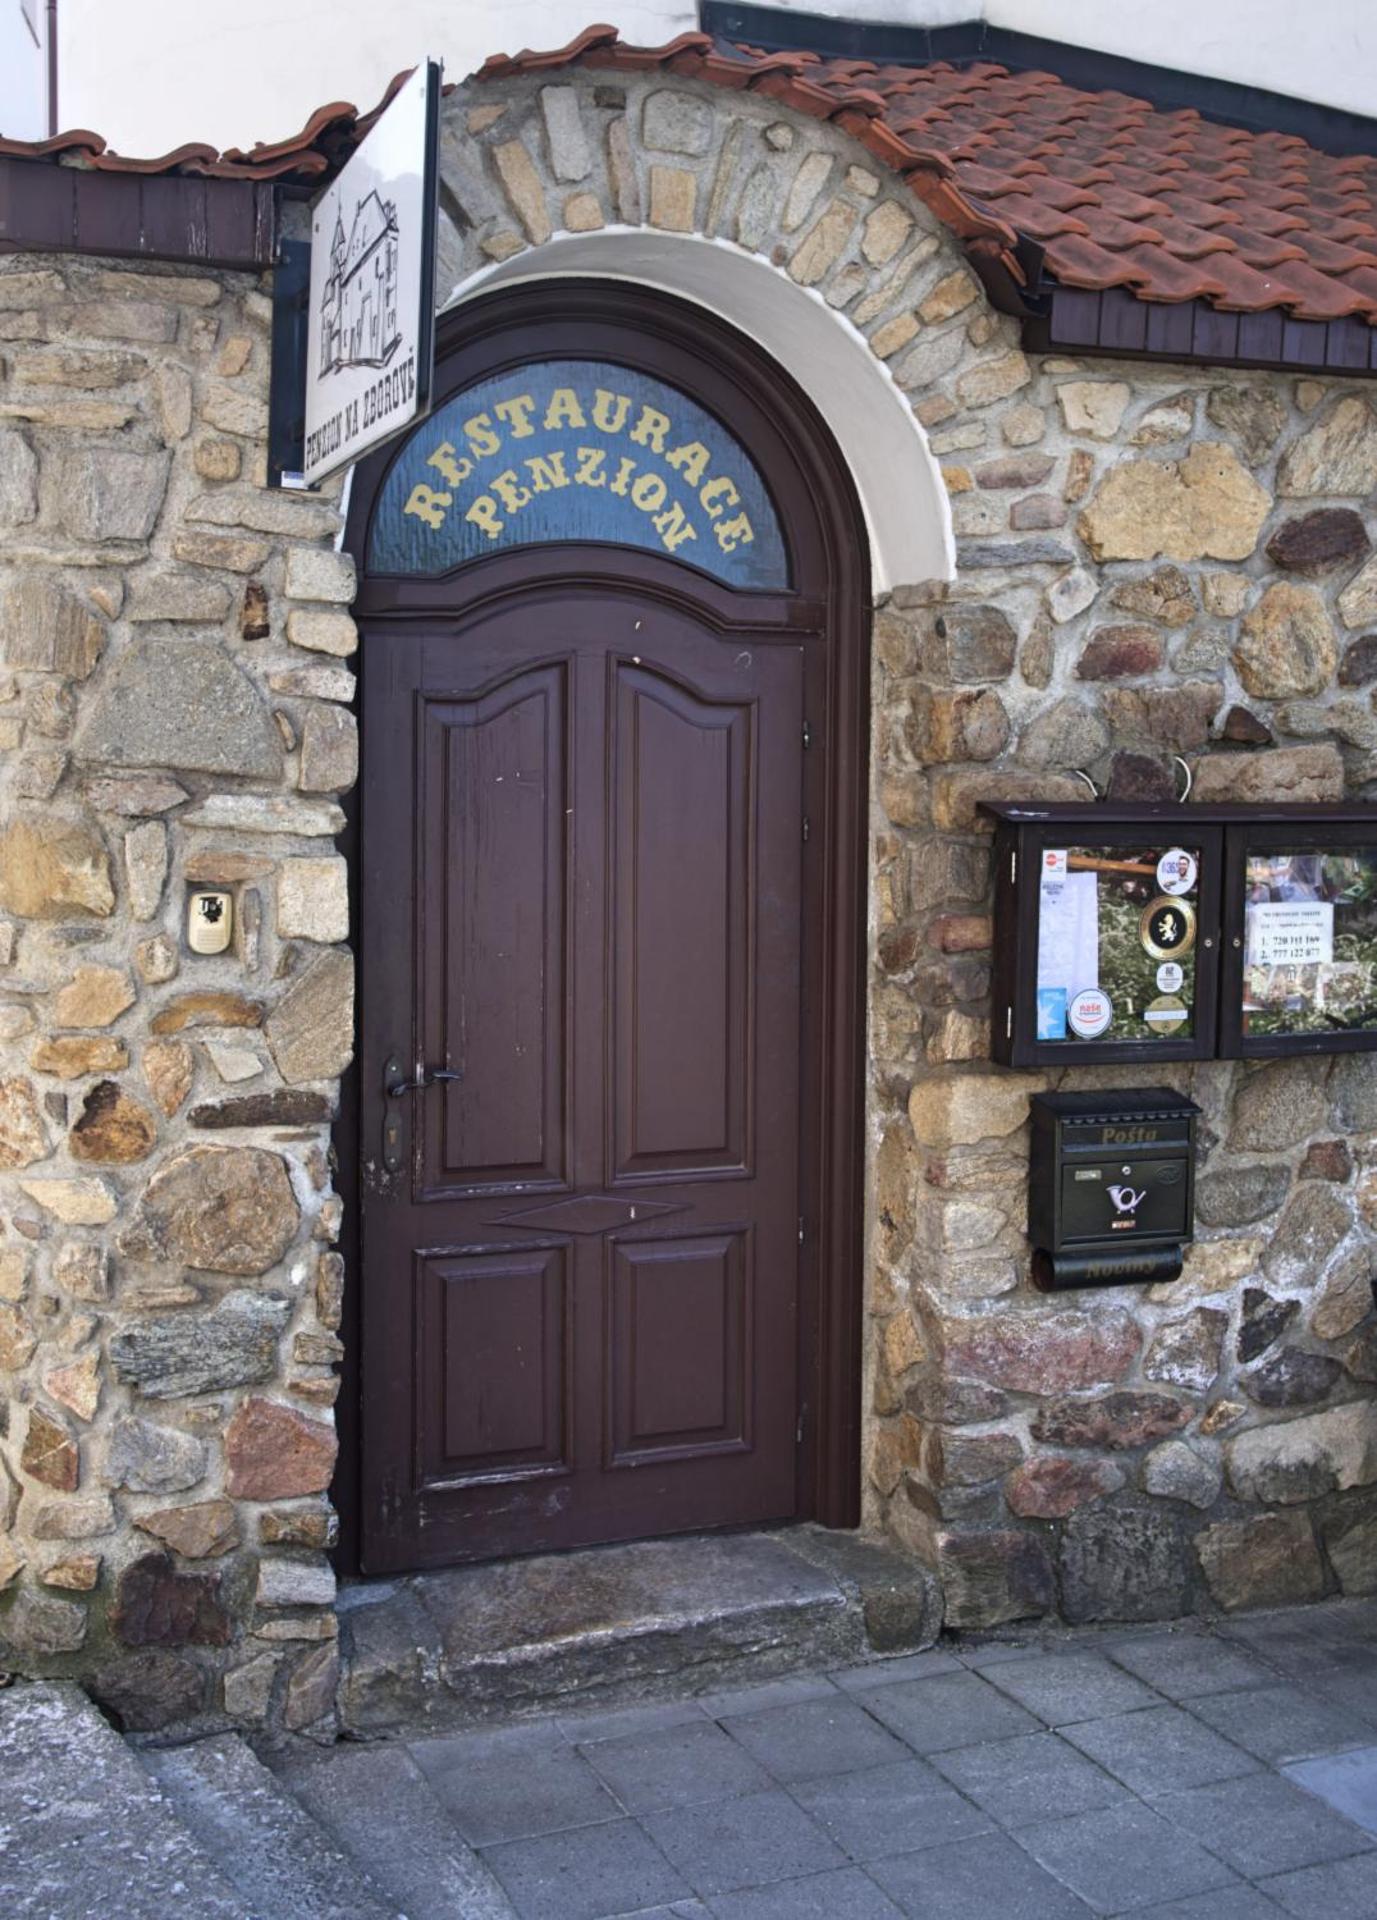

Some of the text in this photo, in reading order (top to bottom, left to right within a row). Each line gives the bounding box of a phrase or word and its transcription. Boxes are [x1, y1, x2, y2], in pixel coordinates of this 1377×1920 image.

[306, 410, 342, 470] PENZION
[345, 399, 358, 442] NA
[404, 388, 754, 554] RESTAURACE
[465, 446, 698, 552] PENZION
